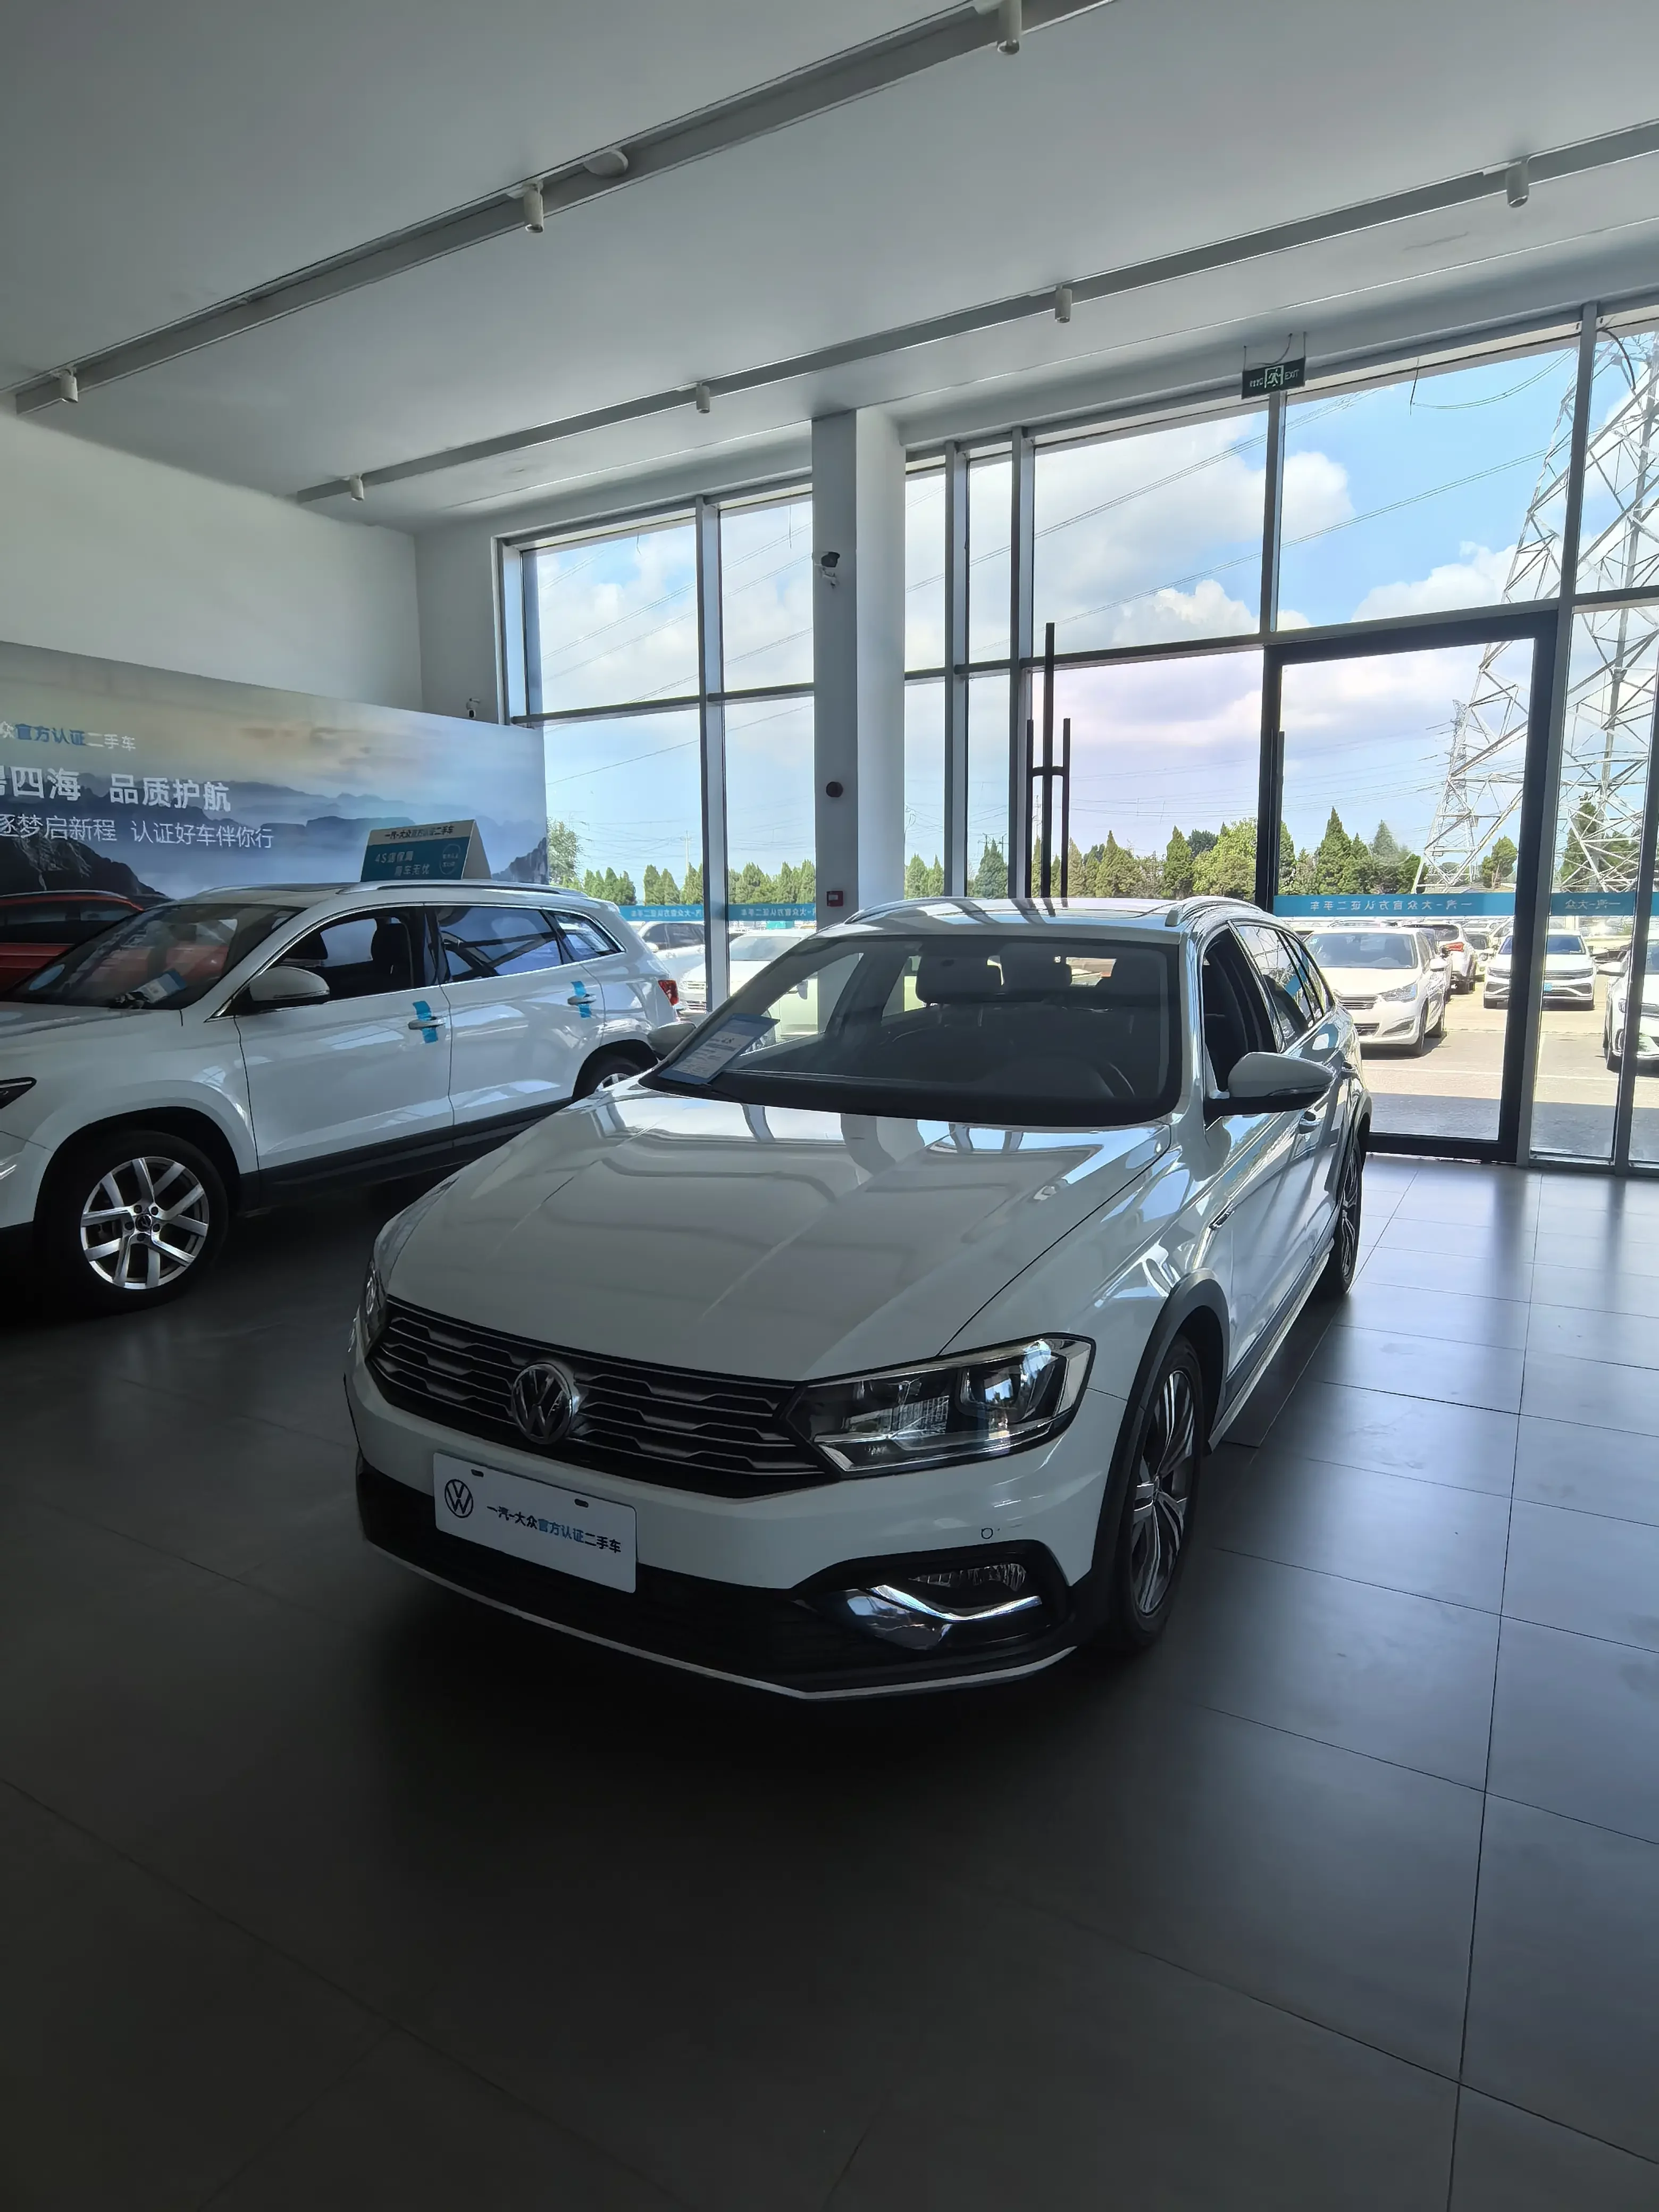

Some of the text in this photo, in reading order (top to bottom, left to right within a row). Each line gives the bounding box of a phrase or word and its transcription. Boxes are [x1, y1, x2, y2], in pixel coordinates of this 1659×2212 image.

[0, 765, 231, 812] 四海 品质护航
[0, 813, 274, 849] 逐梦启新程 认证好车伴你行
[486, 1505, 622, 1554] 一汽-大众官方认证二手车
